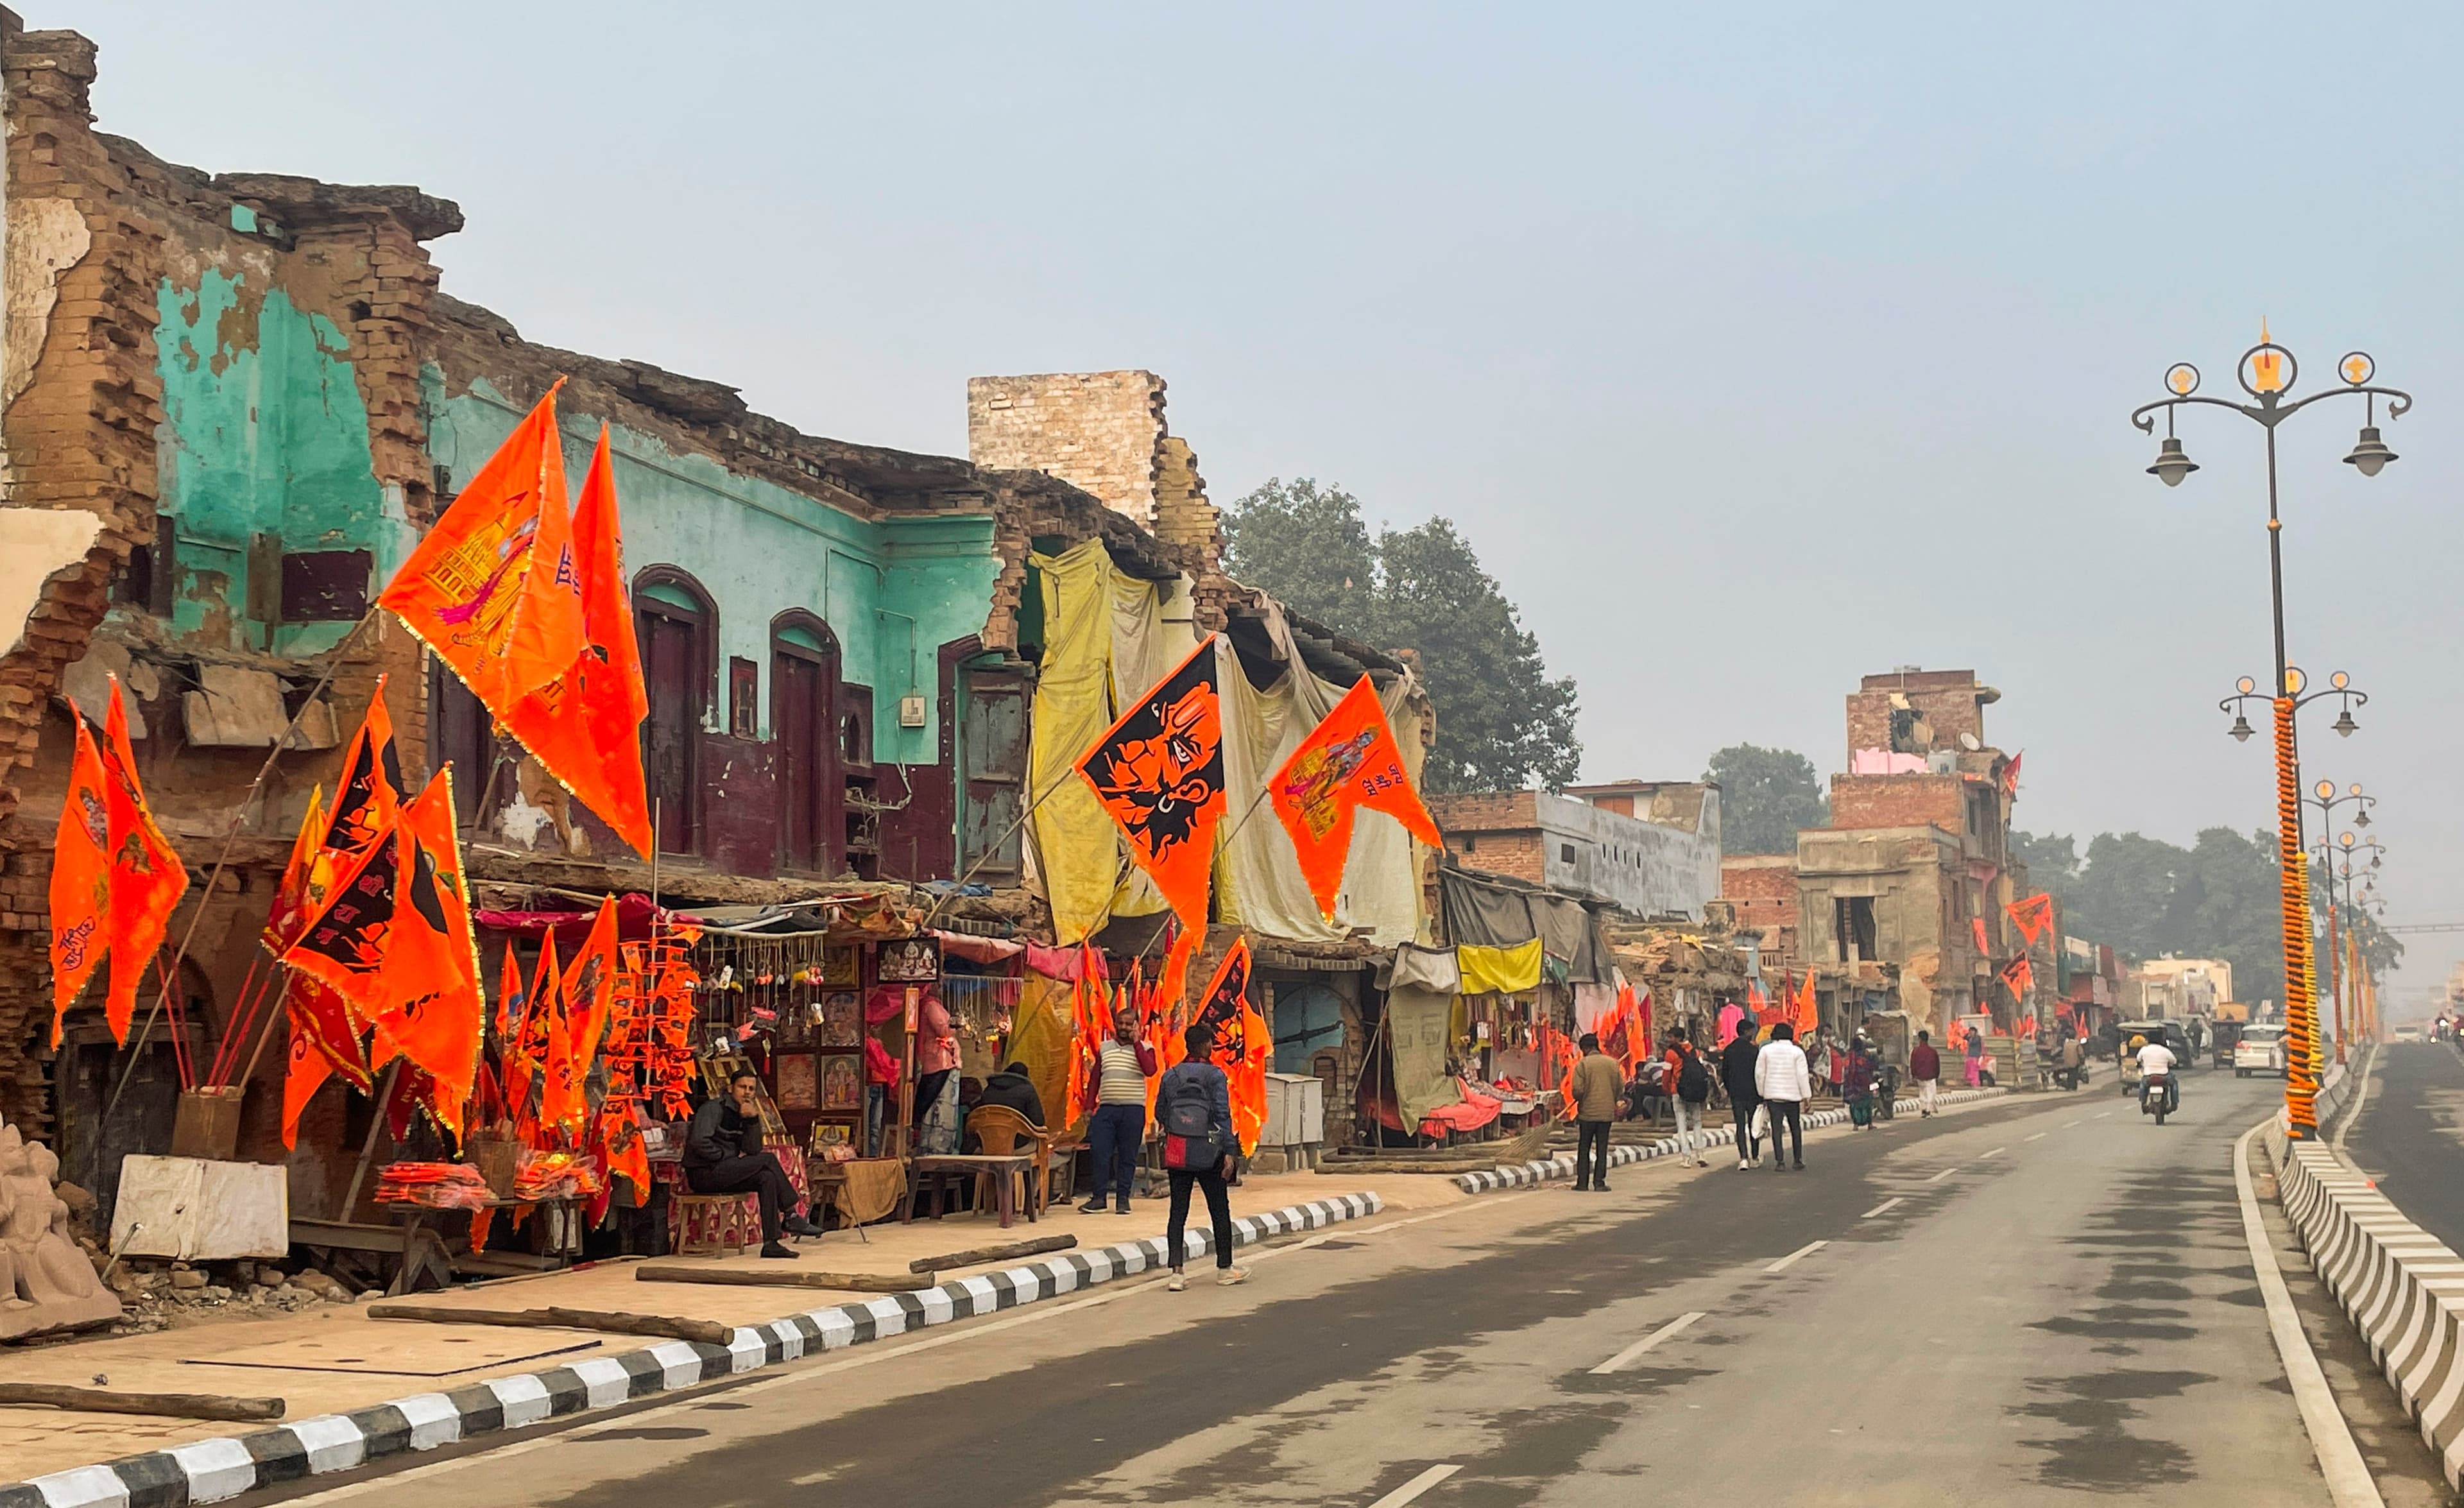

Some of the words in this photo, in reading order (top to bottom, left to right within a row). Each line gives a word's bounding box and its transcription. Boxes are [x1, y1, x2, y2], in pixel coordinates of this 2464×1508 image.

[1374, 774, 1392, 789] श्री
[1388, 762, 1404, 784] जय
[1362, 777, 1379, 796] राम
